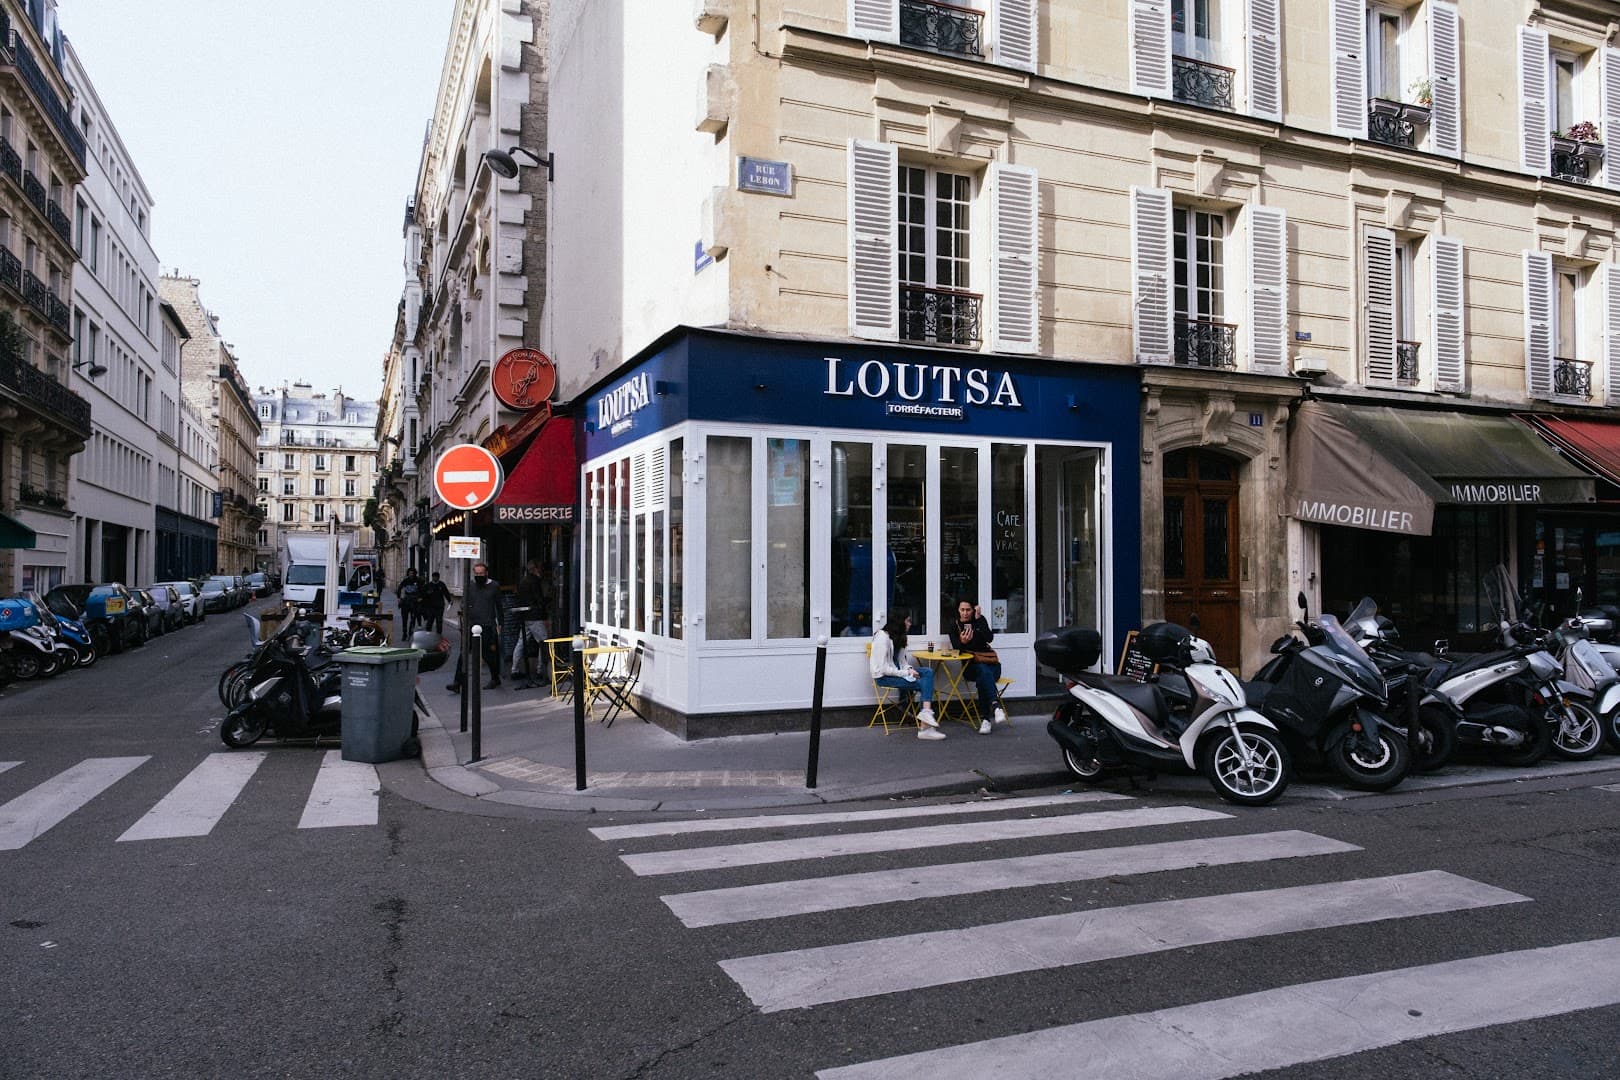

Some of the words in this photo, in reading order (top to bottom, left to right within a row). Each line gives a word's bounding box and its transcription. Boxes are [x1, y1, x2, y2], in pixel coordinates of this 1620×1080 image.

[755, 164, 776, 175] RUE
[750, 174, 780, 186] LEBON
[824, 357, 1022, 407] LOUTSA
[598, 371, 650, 430] LOUTSA
[888, 404, 961, 416] TORRÉFACTEUR
[1252, 415, 1261, 425] 11
[1452, 484, 1541, 502] IMMOBILIER
[499, 507, 573, 520] BRASSERIE
[1296, 500, 1413, 532] IMMOBILIER
